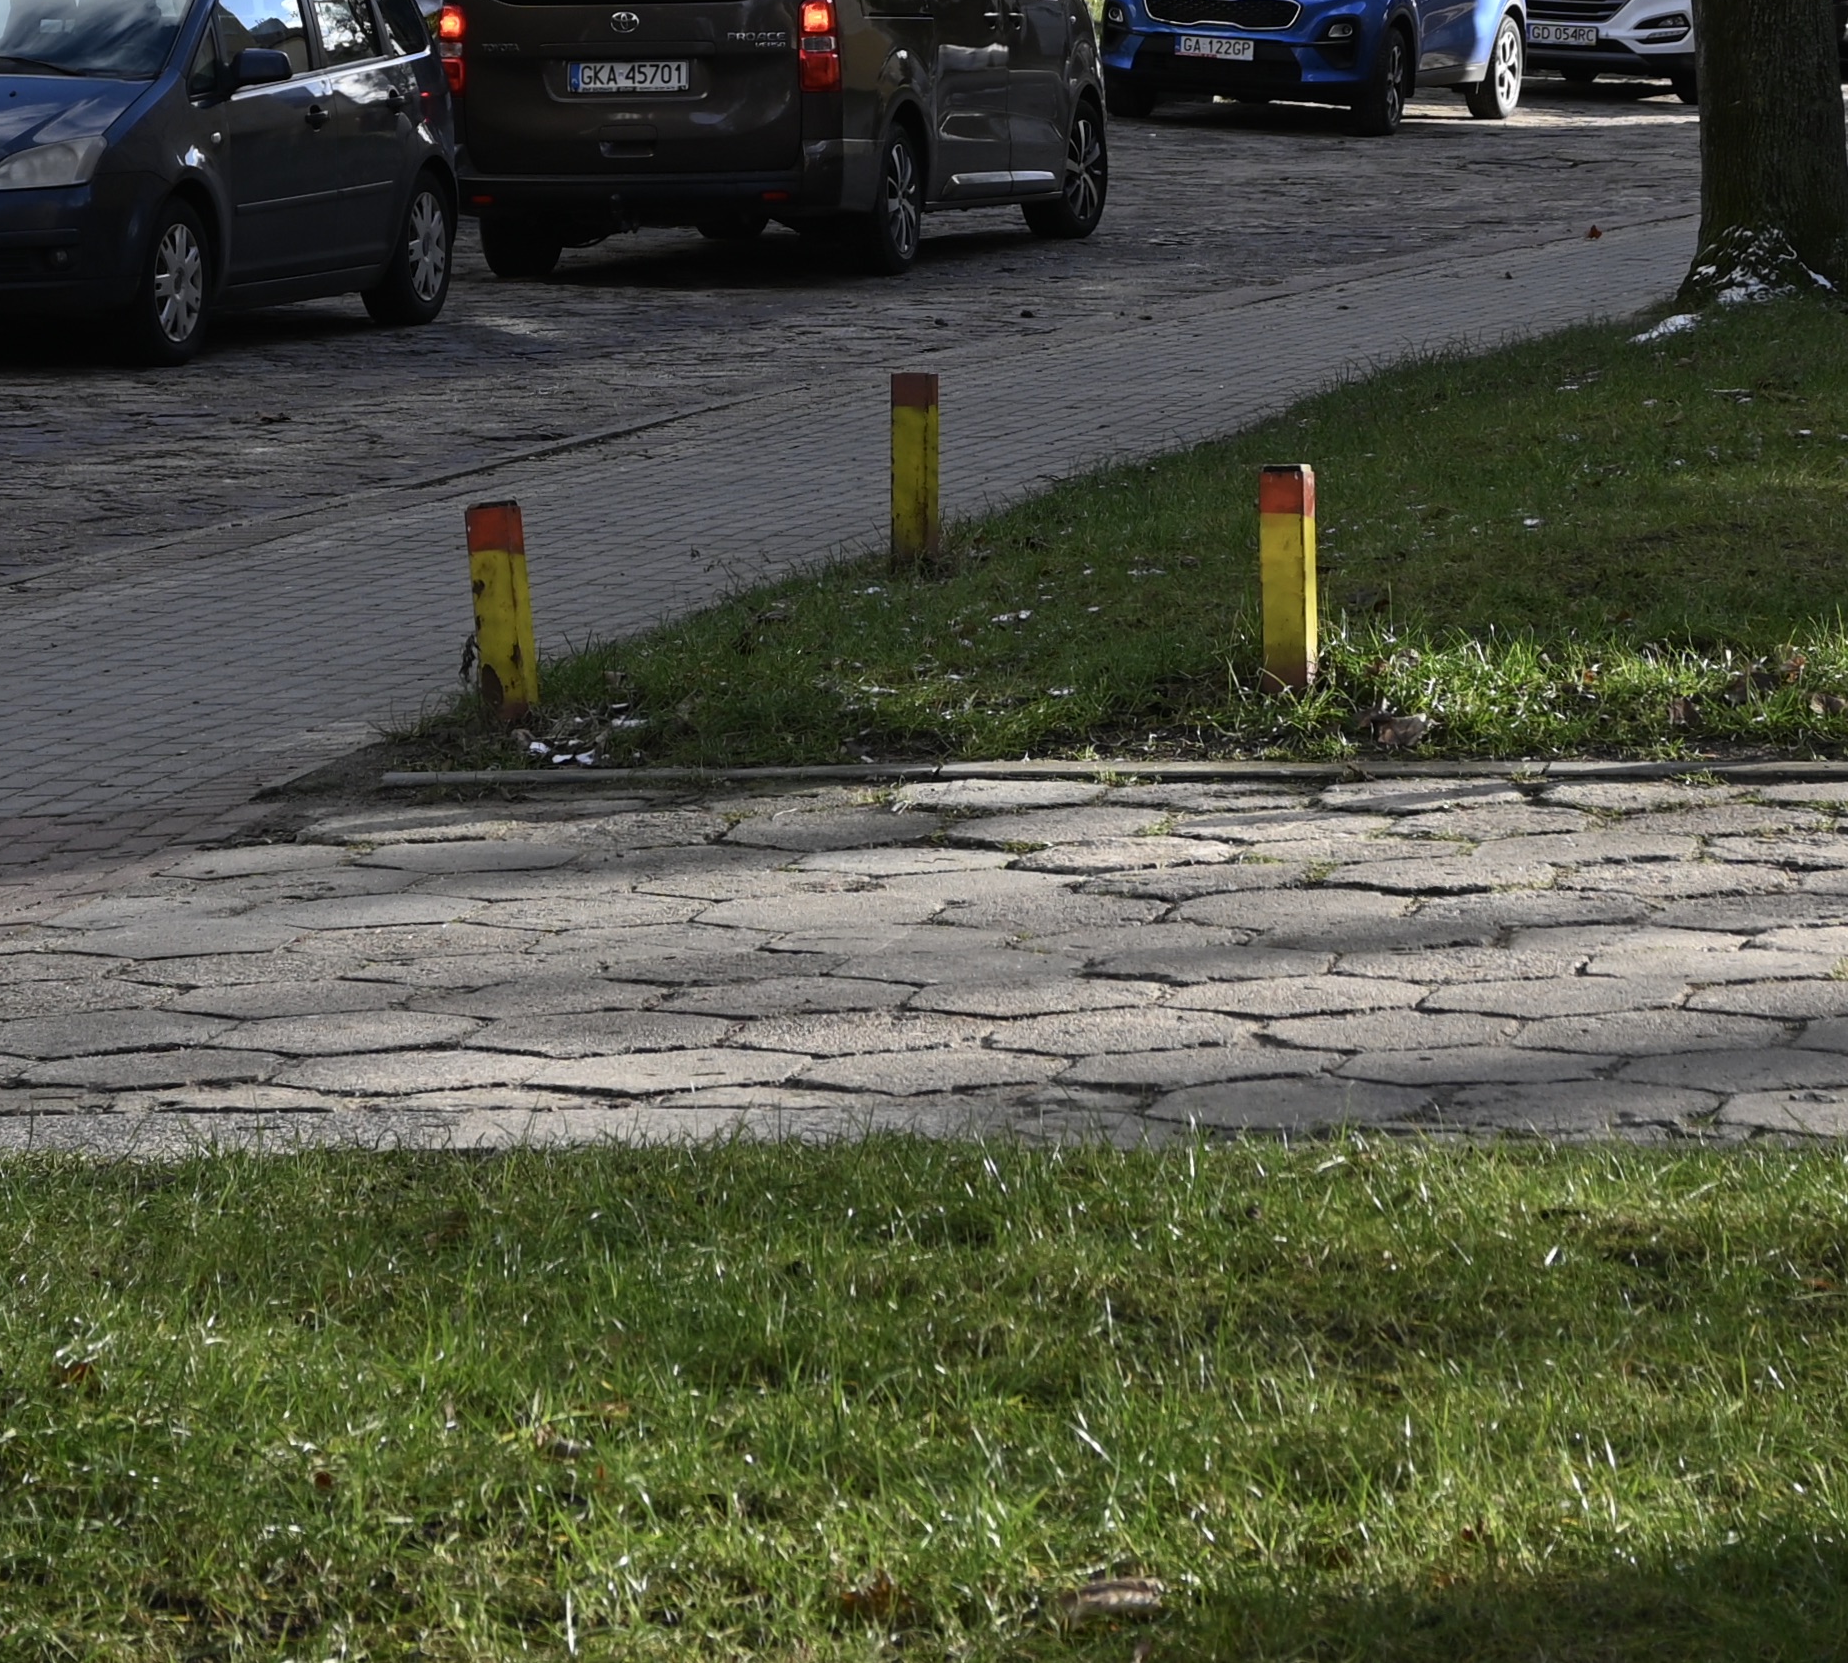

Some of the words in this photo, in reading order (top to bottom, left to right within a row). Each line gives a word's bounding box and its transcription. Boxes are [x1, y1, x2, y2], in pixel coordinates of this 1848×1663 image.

[727, 32, 786, 41] PROACE
[1532, 26, 1550, 40] GD
[1555, 27, 1594, 42] 054RC
[481, 43, 520, 53] TOYOTA
[1183, 37, 1201, 53] GA
[1208, 39, 1251, 56] 122GP
[581, 64, 618, 86] GKA
[625, 63, 681, 85] 45701
